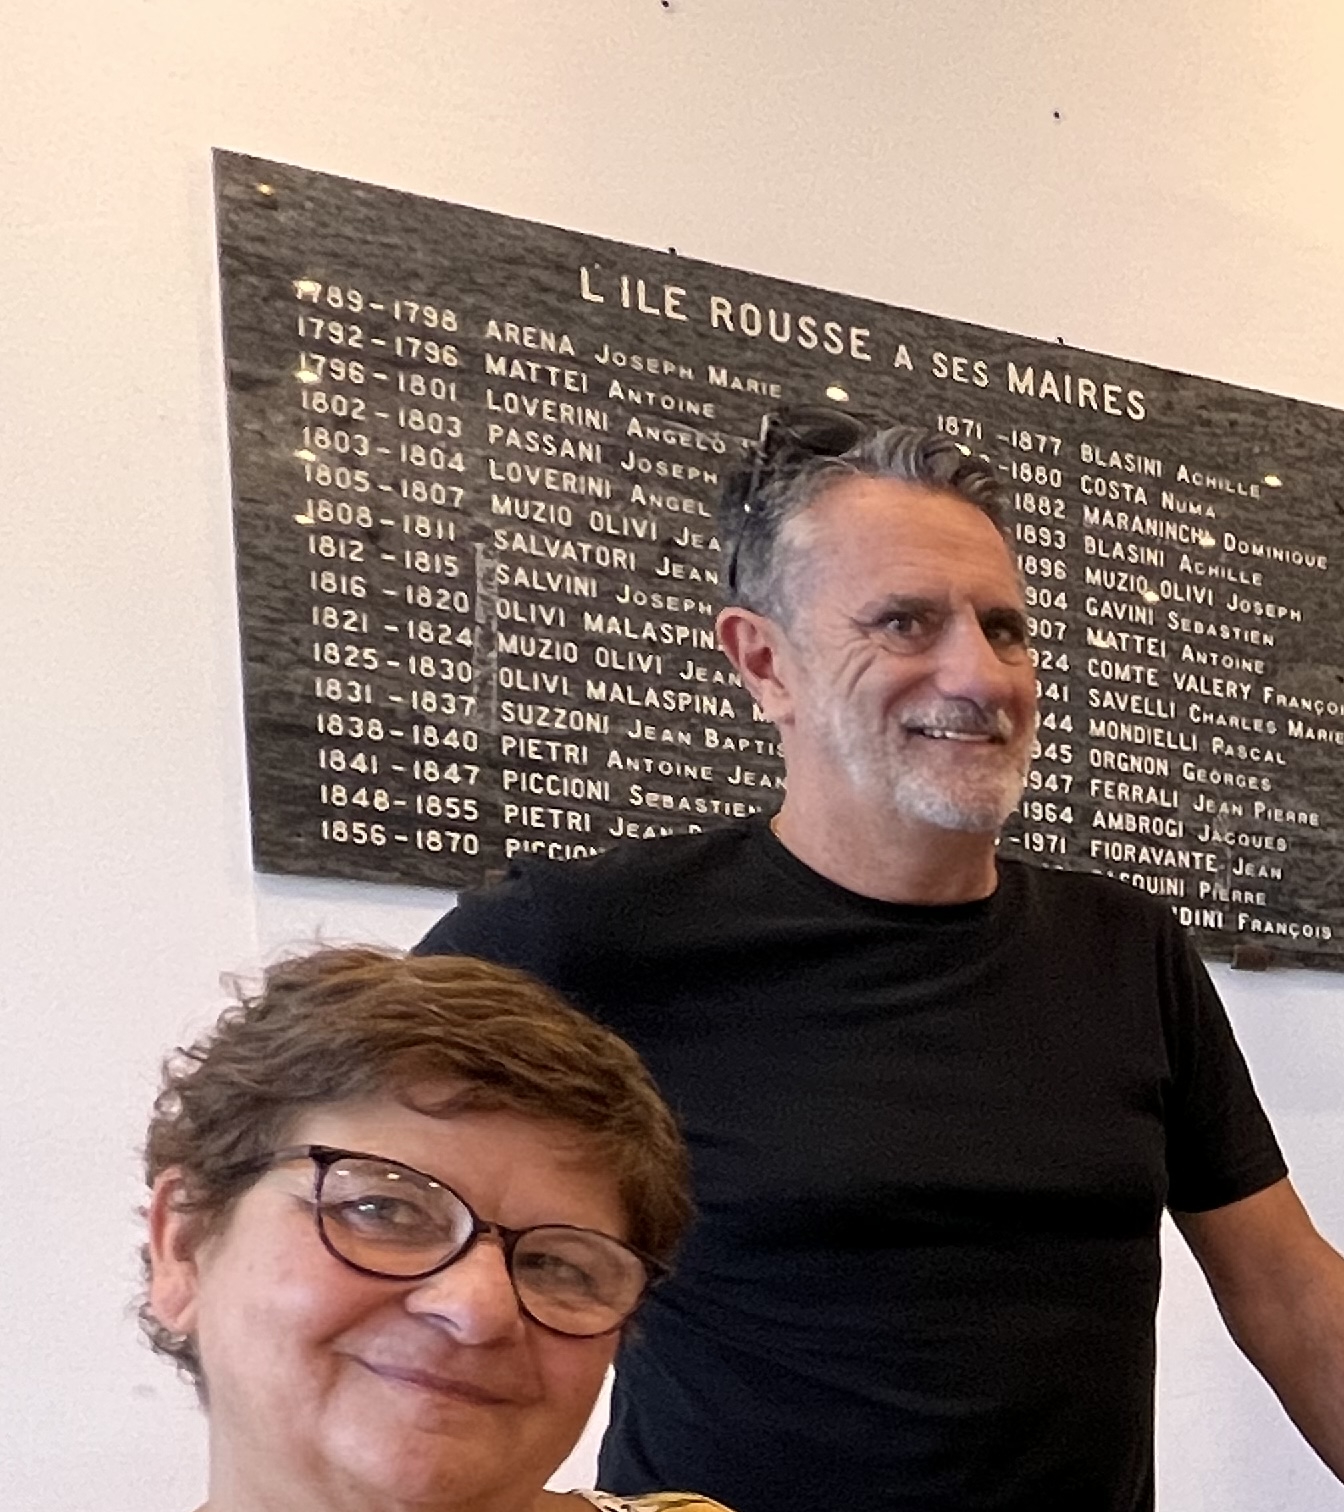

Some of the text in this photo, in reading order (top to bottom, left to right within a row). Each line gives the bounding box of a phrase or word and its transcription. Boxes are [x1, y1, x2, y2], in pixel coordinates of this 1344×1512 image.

[485, 319, 575, 356] ARENA
[485, 353, 588, 394] MATTEI
[710, 296, 871, 361] ROUSSE
[894, 344, 914, 371] A
[932, 353, 990, 388] SES
[1007, 362, 1147, 421] MAIRES
[486, 388, 609, 431] LOVERINI
[488, 424, 600, 464] PASSANI
[1080, 442, 1162, 477] BLASINI
[488, 459, 612, 499] LOVERINI
[1080, 474, 1147, 505] COSTA
[490, 494, 573, 528] MUZIO
[589, 510, 657, 541] OLIVI
[673, 526, 721, 552] JEA
[494, 530, 635, 571] SALVATORI
[1084, 535, 1164, 567] BLASINI
[496, 563, 597, 598] SALVINI
[1085, 566, 1148, 594] MUZIO
[1160, 580, 1214, 606] OLIVI
[496, 599, 566, 628] OLIVI
[583, 612, 724, 650] MALASPIN
[1086, 597, 1154, 626] GAVINI
[498, 633, 579, 663] MUZIO
[595, 647, 662, 675] OLIVI
[1086, 626, 1166, 659] MATTEI
[500, 667, 569, 695] OLIVI
[586, 679, 735, 718] MALASPINA
[1088, 658, 1159, 688] COMTE
[1173, 672, 1251, 700] VALERY
[501, 701, 609, 735] SUZZONI
[1088, 688, 1176, 719] SAVELLI
[501, 735, 588, 765] PIETRI
[1089, 718, 1198, 751] MONDIELLI
[1089, 749, 1169, 777] ORGNON
[502, 769, 610, 801] PICCIONI
[1090, 779, 1178, 808] FERRALI
[504, 804, 591, 833] PIETRI
[1092, 810, 1184, 838] AMBROGI
[1090, 840, 1217, 872] FIORAVANTE
